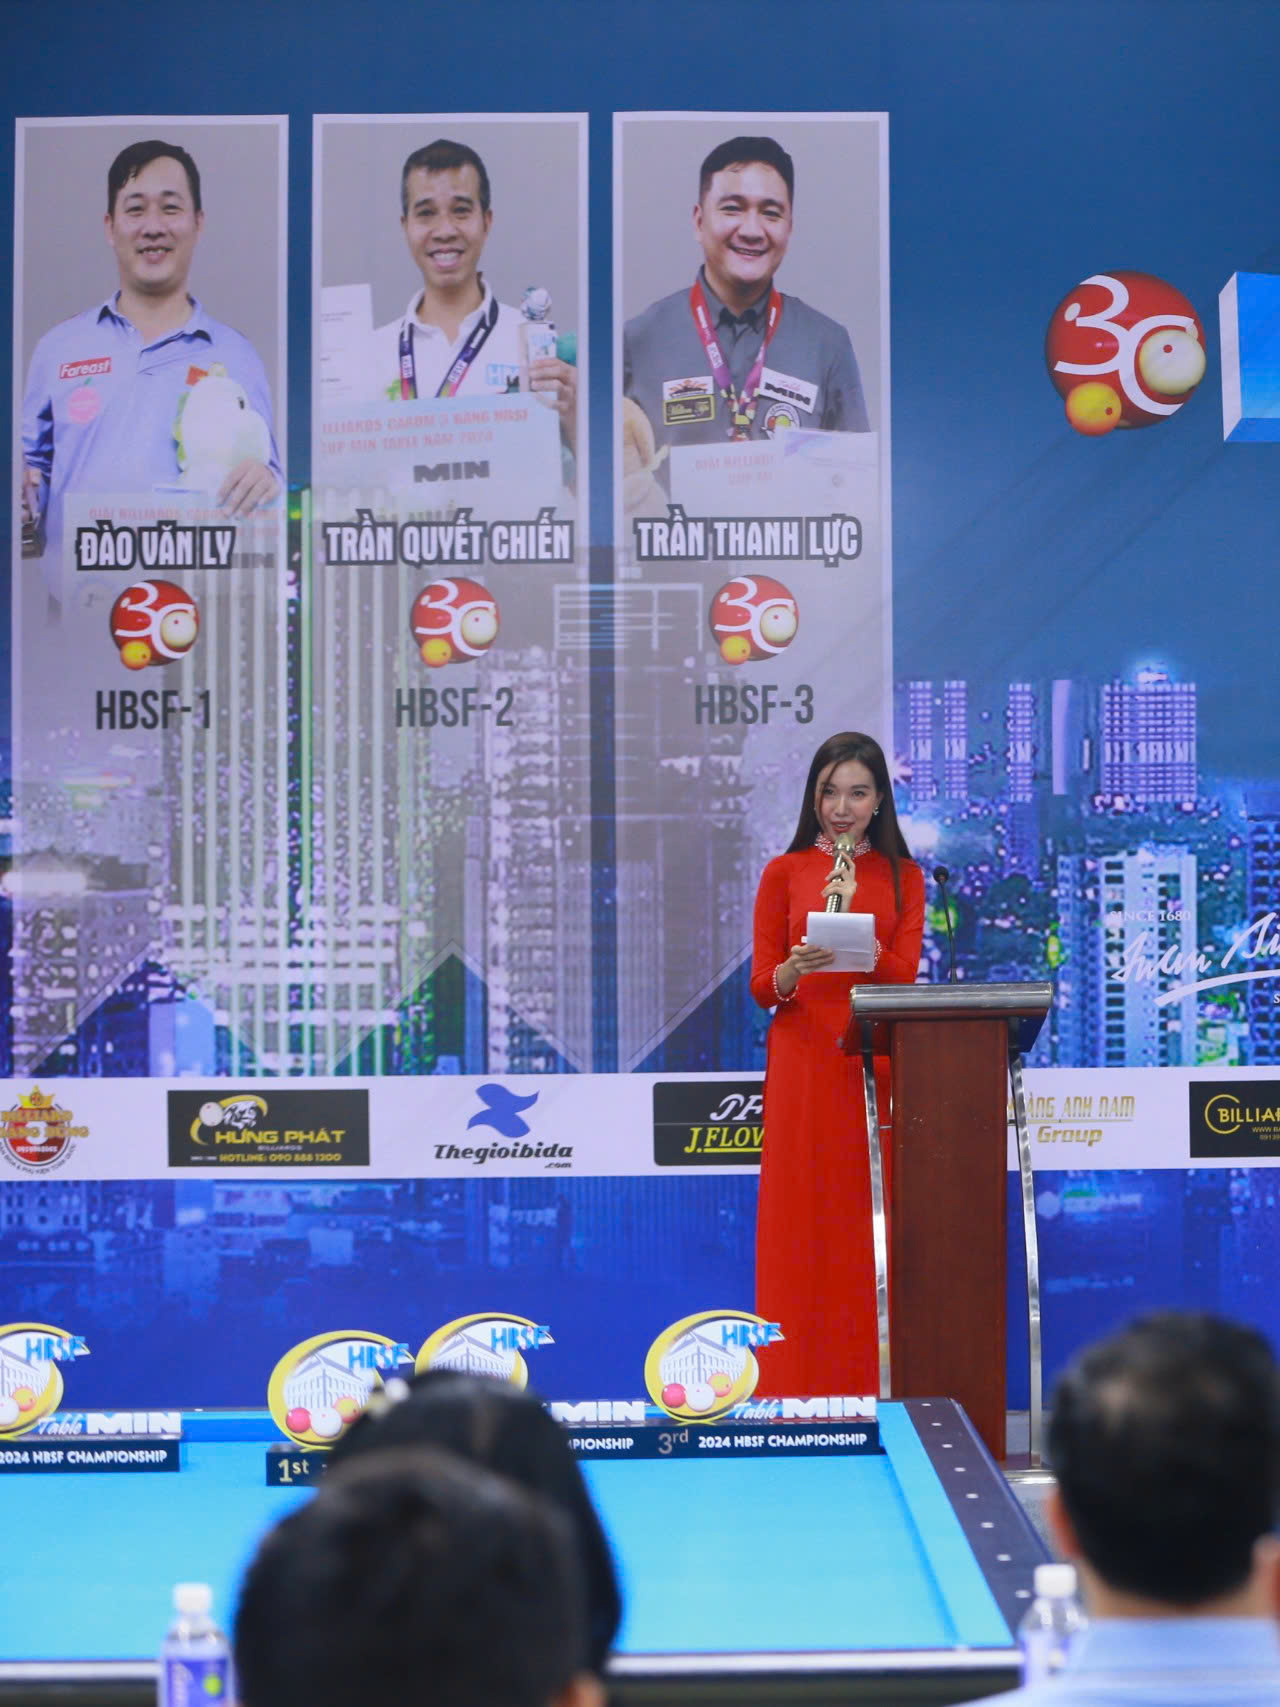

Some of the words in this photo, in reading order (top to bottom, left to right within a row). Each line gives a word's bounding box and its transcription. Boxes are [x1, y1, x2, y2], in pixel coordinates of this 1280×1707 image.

[413, 461, 490, 483] MIN
[78, 522, 135, 569] ĐÀO
[140, 522, 195, 568] VĂN
[201, 528, 234, 568] LY
[324, 511, 395, 564] TRẦN
[401, 511, 485, 566] QUYẾT
[490, 510, 572, 564] CHIẾN
[637, 506, 706, 559] TRẦN
[711, 519, 801, 559] THANH
[807, 516, 860, 565] LỰC
[96, 690, 211, 730] HBSF-1
[395, 687, 514, 728] HBSF-2
[695, 684, 815, 725] HBSF-3
[215, 1128, 280, 1145] HƯNG
[284, 1128, 347, 1144] PHÁT
[1037, 1126, 1104, 1147] Group
[434, 1142, 574, 1164] Thegioibida
[544, 1160, 573, 1169] .com
[491, 1325, 549, 1350] HBSF
[721, 1323, 781, 1347] HBSF
[26, 1335, 86, 1362] HBSF
[348, 1343, 409, 1369] HBSF
[551, 1400, 646, 1422] MIN
[782, 1396, 877, 1419] MIN
[86, 1412, 182, 1434] MIN
[568, 1437, 634, 1450] PIONSHIP
[658, 1429, 689, 1454] 3rd
[698, 1435, 731, 1448] 2024
[733, 1435, 765, 1448] HBSF
[768, 1433, 868, 1447] CHAMPIONSHIP
[0, 1451, 30, 1464] 2024
[32, 1451, 65, 1464] HBSF
[67, 1449, 168, 1464] CHAMPIONSHIP
[278, 1458, 310, 1483] 1st
